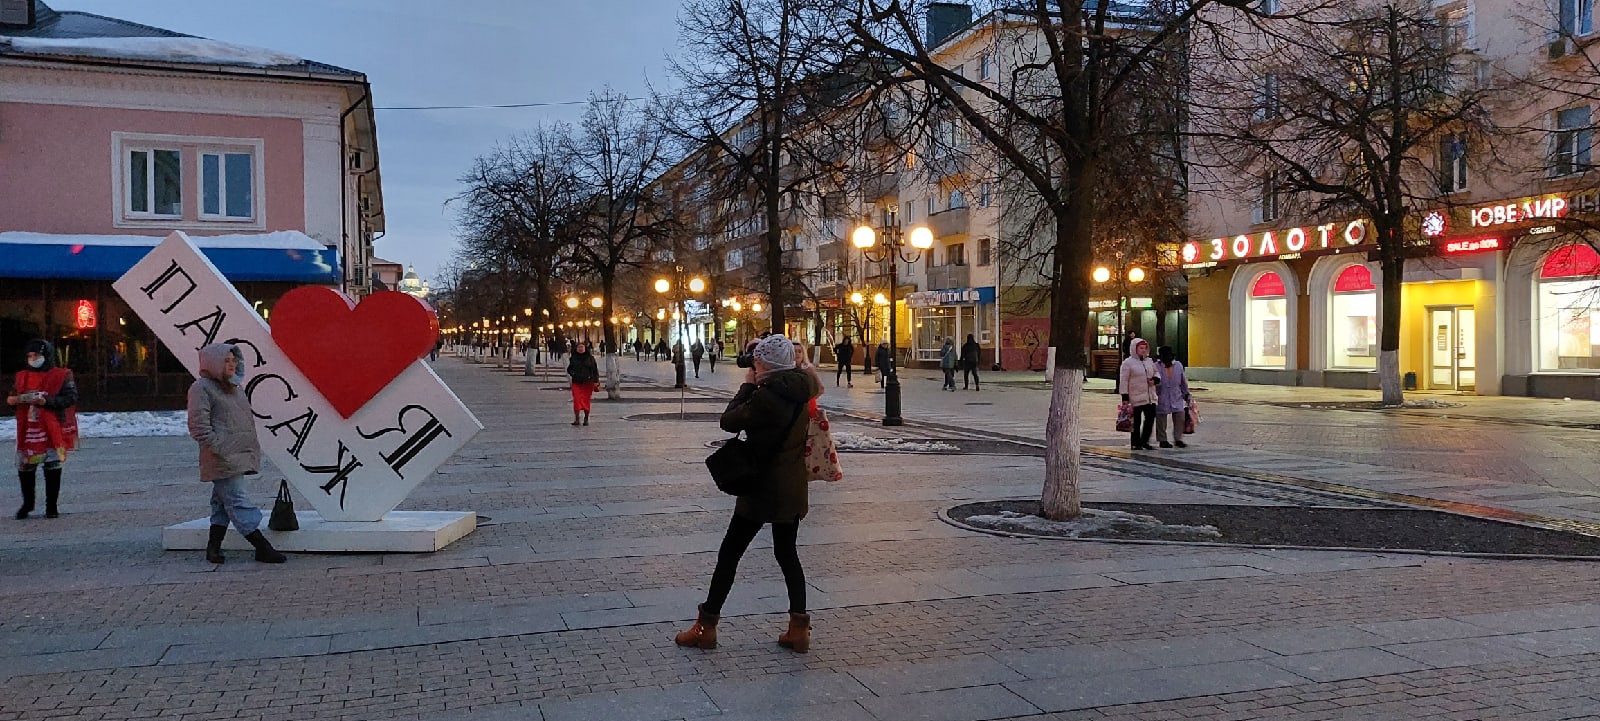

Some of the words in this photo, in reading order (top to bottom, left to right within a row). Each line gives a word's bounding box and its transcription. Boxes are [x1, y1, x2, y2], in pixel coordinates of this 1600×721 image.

[1210, 219, 1367, 260] ЗОЛОТО
[140, 259, 363, 511] ПАССАЖ
[356, 404, 453, 481] Я
